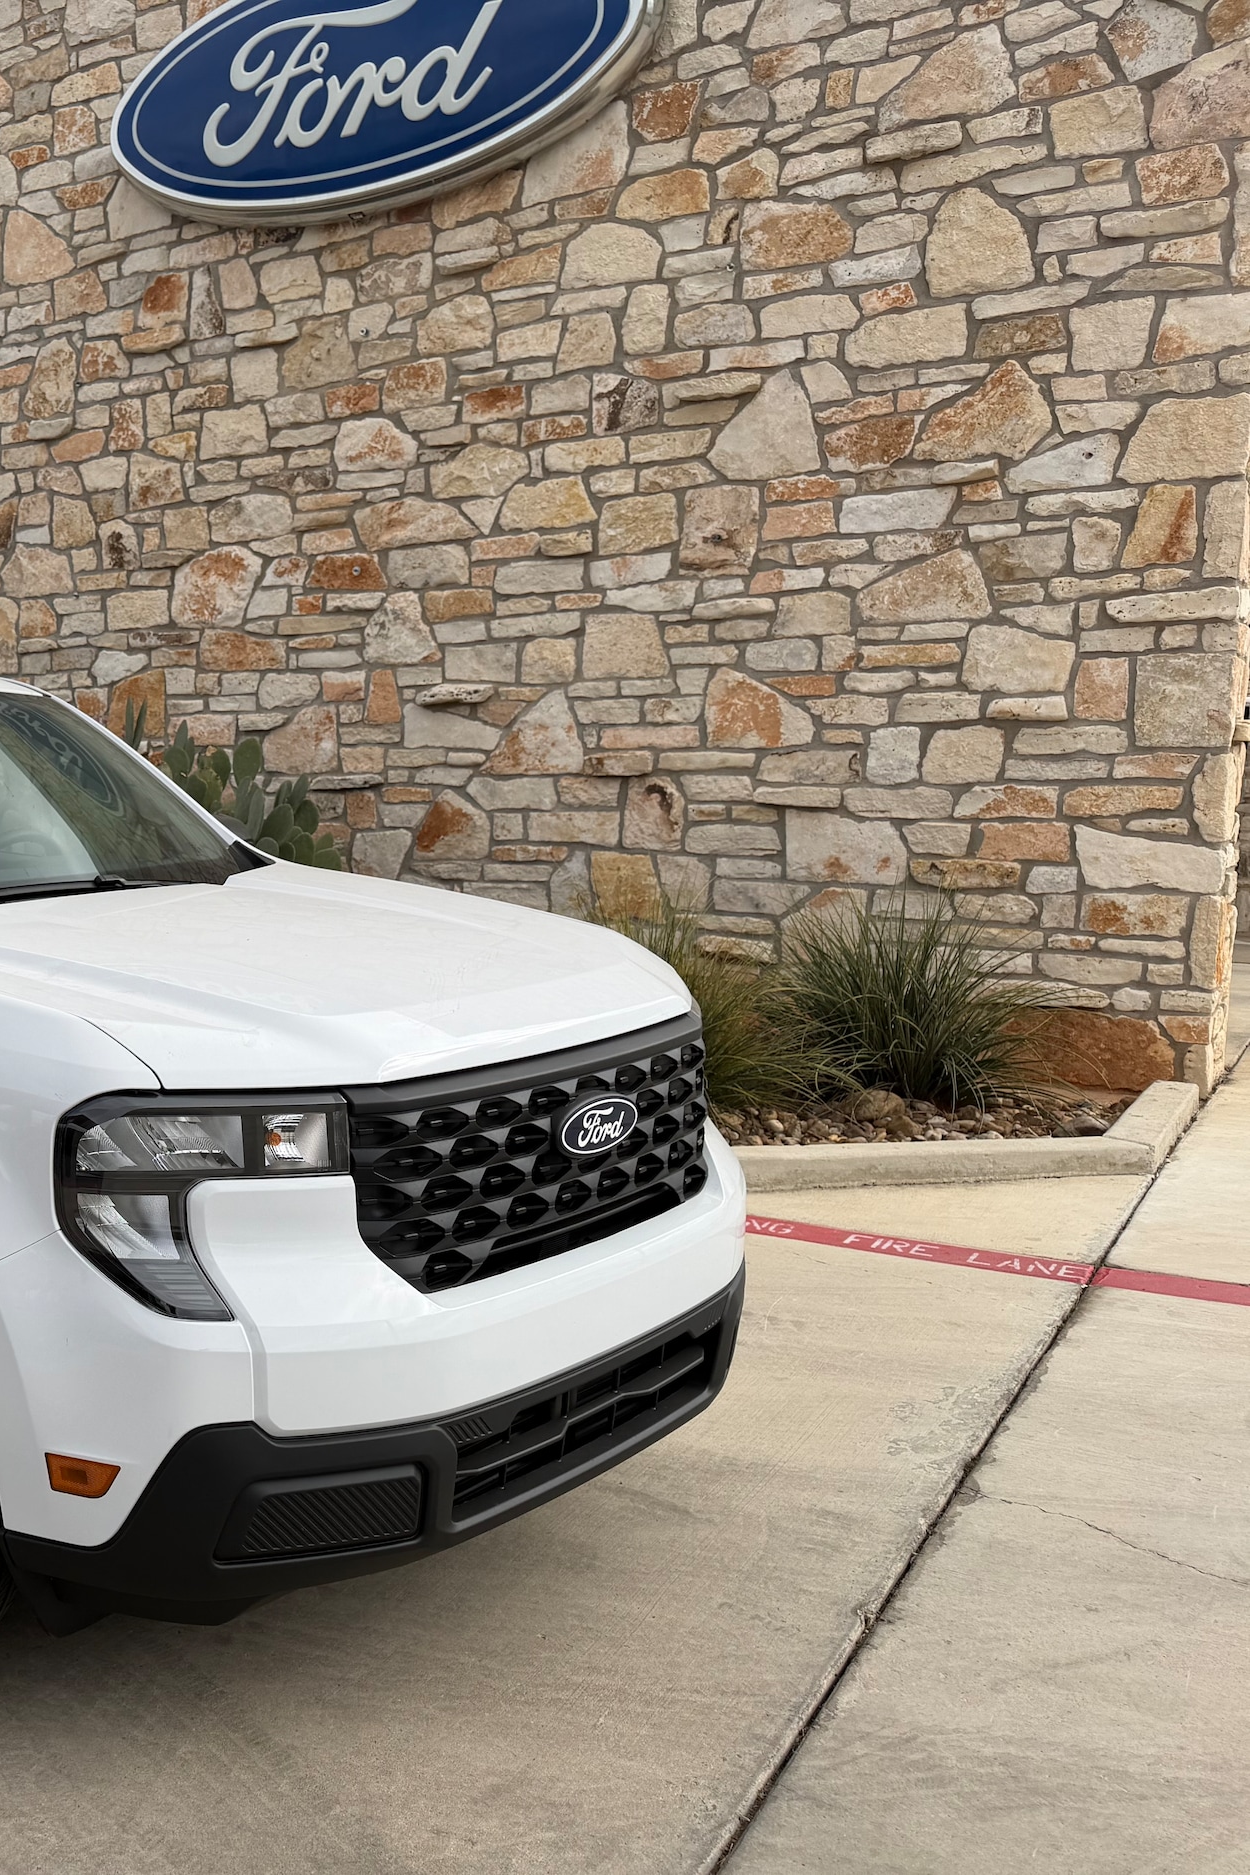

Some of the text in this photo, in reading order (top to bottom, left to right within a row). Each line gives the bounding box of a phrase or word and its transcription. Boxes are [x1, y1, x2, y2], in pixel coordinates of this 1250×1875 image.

[203, 0, 502, 167] Ford
[578, 1106, 625, 1148] Ford
[843, 1233, 940, 1257] FIRE
[966, 1252, 1088, 1280] LANE
